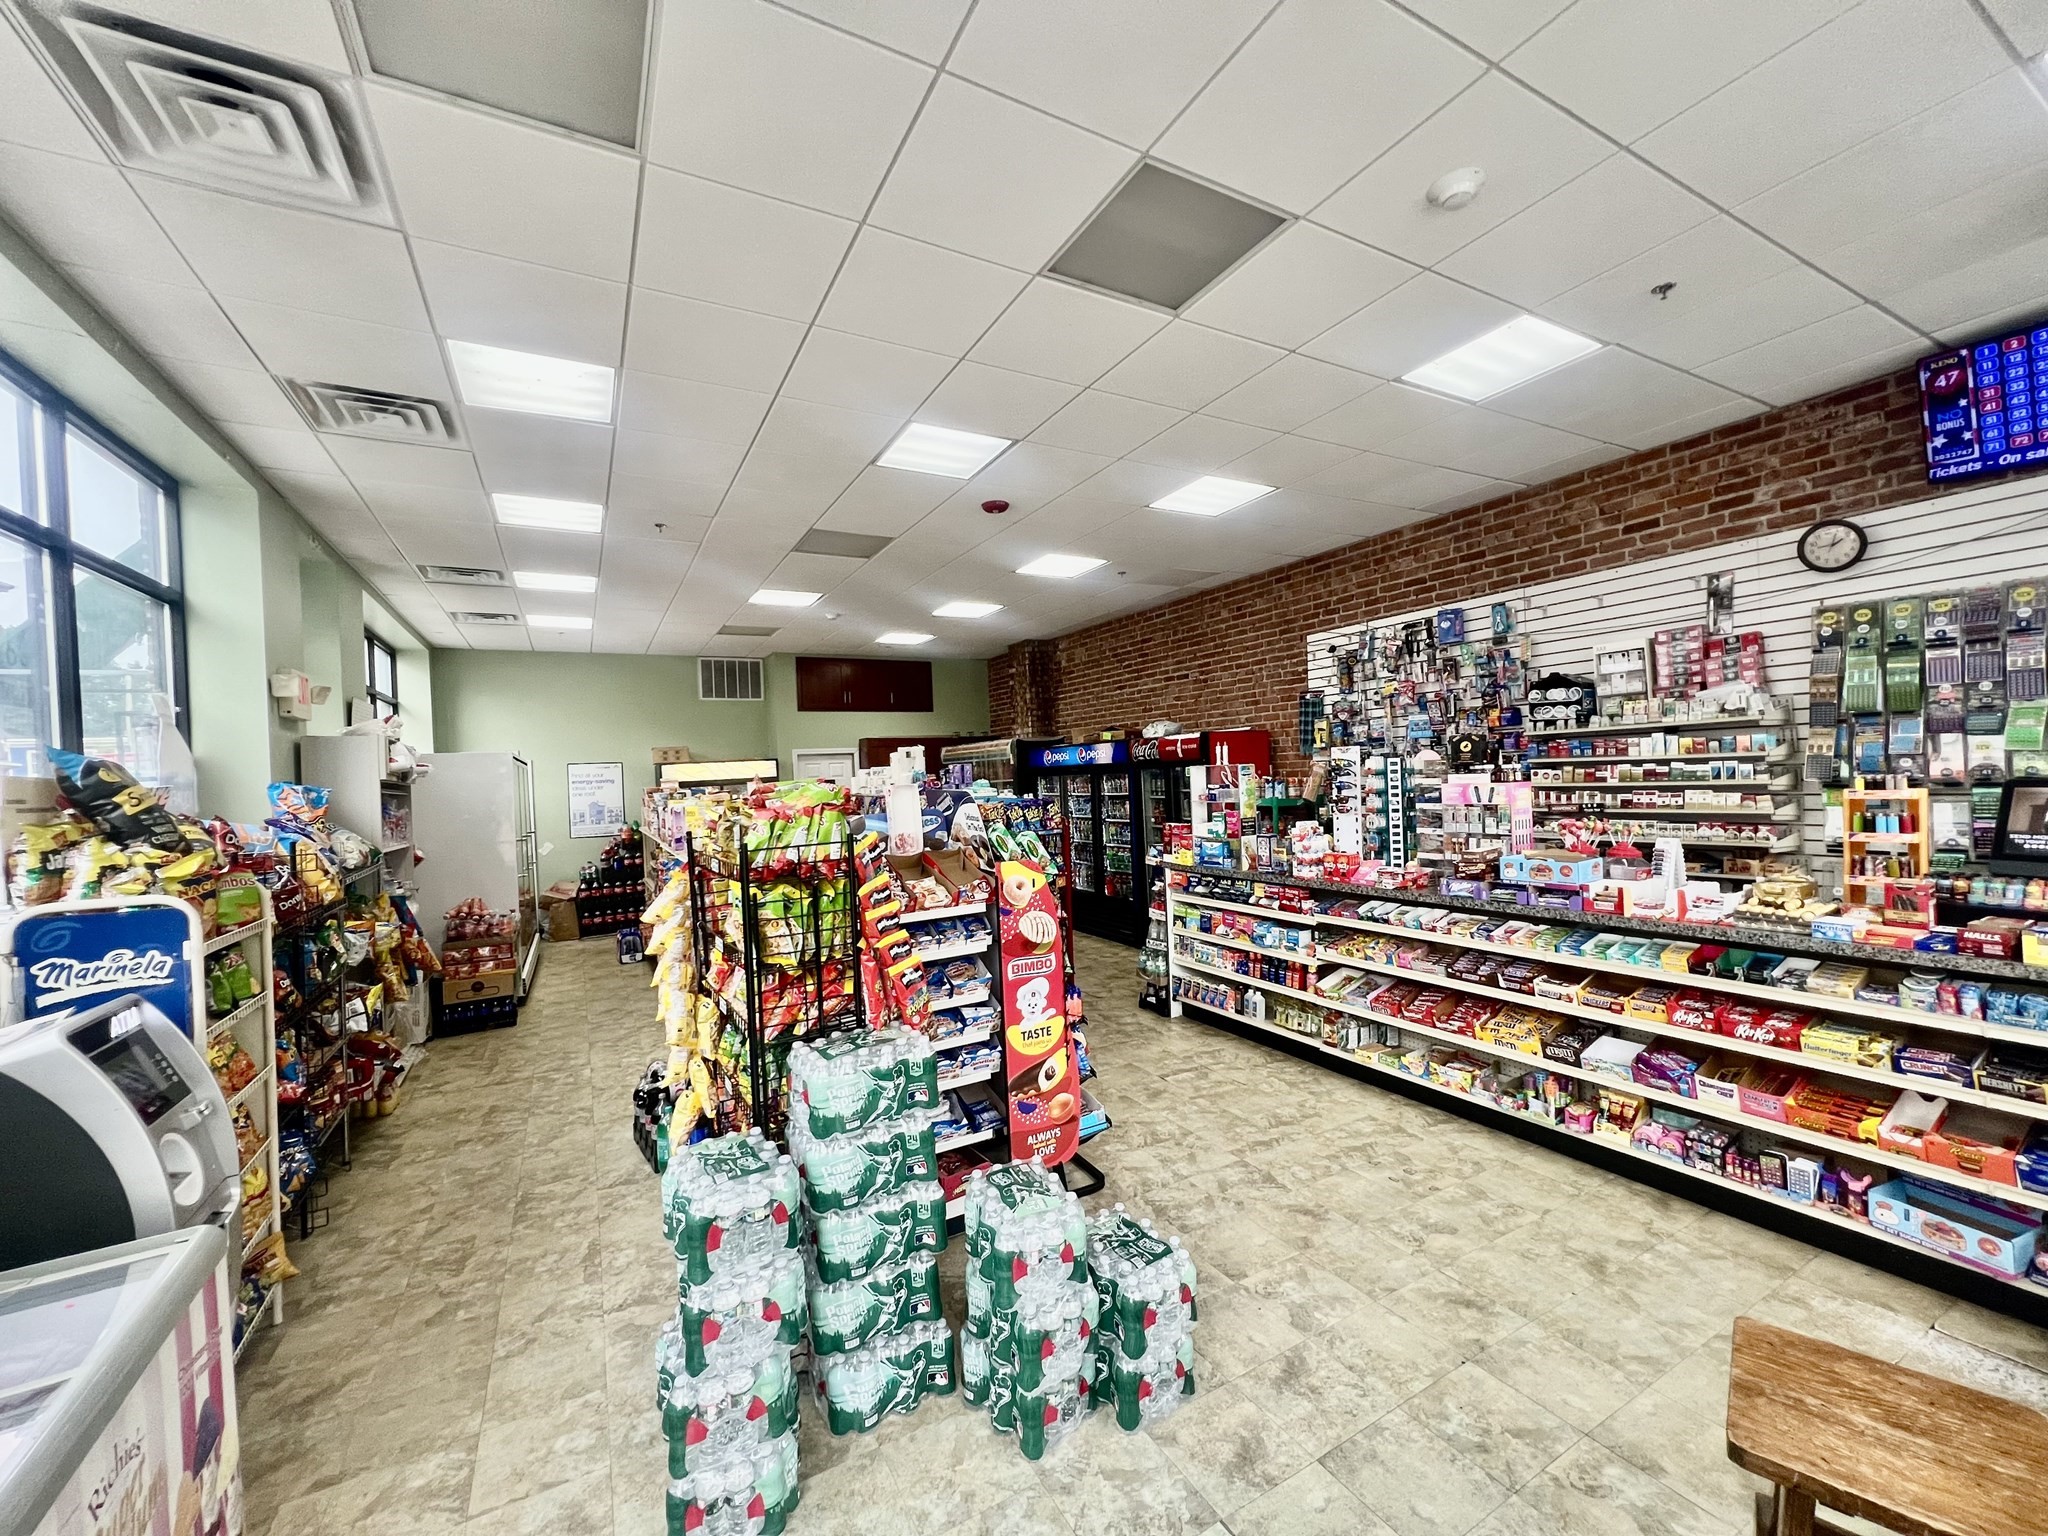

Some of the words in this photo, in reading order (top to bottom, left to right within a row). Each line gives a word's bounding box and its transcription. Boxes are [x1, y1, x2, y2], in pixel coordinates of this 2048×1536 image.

[2011, 340, 2019, 348] 2
[2040, 331, 2048, 340] 3
[1930, 357, 1958, 369] KENO
[1982, 362, 1992, 370] 11
[2010, 354, 2022, 362] 12
[1934, 370, 1960, 387] 47
[2008, 367, 2024, 376] 22
[2010, 381, 2025, 390] 32
[2011, 395, 2026, 404] 42
[1937, 410, 1962, 422] NO
[1986, 416, 1997, 424] 51
[2012, 409, 2027, 418] 52
[1936, 418, 1965, 431] BONUS
[1987, 430, 1998, 438] 61
[2013, 423, 2028, 432] 62
[1988, 442, 2000, 450] 71
[2014, 436, 2029, 445] 72
[1929, 461, 1982, 479] Tickets
[1998, 452, 2020, 464] On
[2026, 447, 2048, 460] sal
[1052, 751, 1069, 763] pepsi
[1086, 748, 1106, 760] pepsi
[1813, 924, 1850, 933] mentos
[1963, 931, 2002, 942] HALLS
[37, 954, 168, 987] Marinela
[1011, 956, 1053, 977] BIMBO
[1583, 996, 1610, 1008] SNICKERS
[110, 1006, 142, 1039] ATM
[1021, 1026, 1052, 1041] TASTE
[1735, 1023, 1776, 1043] KitKat
[1804, 1043, 1852, 1056] Butterfinger
[911, 1061, 922, 1070] 24
[1903, 1060, 1946, 1075] CRUNCH
[827, 1078, 866, 1098] Poland
[1980, 1076, 2027, 1093] HERSHEY'S
[832, 1088, 868, 1109] Spring
[907, 1133, 918, 1143] 24
[1027, 1127, 1061, 1146] ALWAYS
[1034, 1143, 1056, 1157] LOVE
[821, 1152, 862, 1174] Poland
[826, 1163, 865, 1186] Spring
[918, 1203, 929, 1213] 24
[832, 1226, 871, 1244] Poland
[1872, 1222, 1886, 1231] ONE
[1886, 1226, 1899, 1236] SET
[1899, 1232, 1921, 1244] SUGAR
[1921, 1240, 1949, 1255] EDITION
[837, 1236, 874, 1257] Spring
[913, 1272, 924, 1281] 24
[825, 1295, 864, 1318] Poland
[828, 1304, 867, 1328] Spring
[933, 1344, 944, 1353] 24
[850, 1380, 887, 1404] Spring
